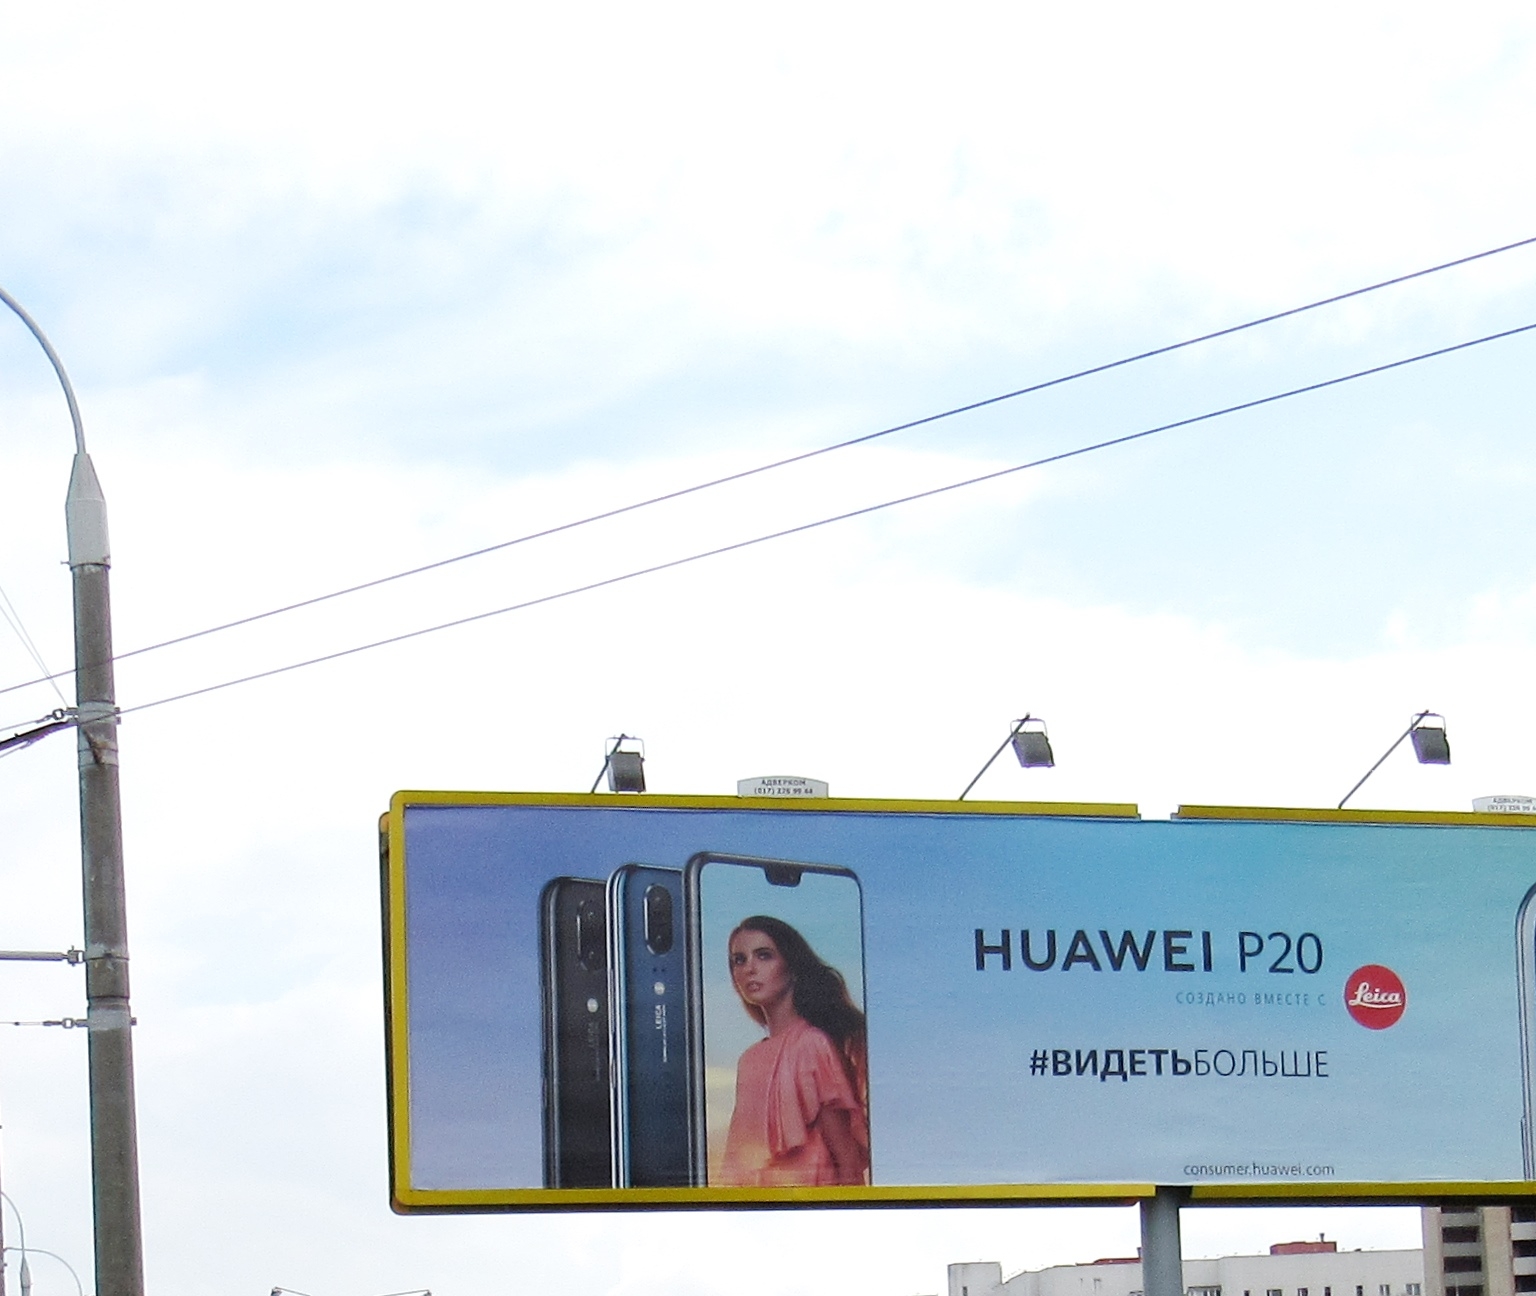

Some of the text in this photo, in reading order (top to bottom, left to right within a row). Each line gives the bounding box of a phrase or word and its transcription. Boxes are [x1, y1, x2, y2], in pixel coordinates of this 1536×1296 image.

[974, 928, 1324, 975] HUAWEI P20
[1175, 991, 1326, 1007] СОЗДАНО ВМЕСТЕ С
[1348, 981, 1403, 1009] Leica
[1029, 1048, 1330, 1083] #ВИДЕТЬБОЛЬШЕ
[1183, 1162, 1336, 1176] consumer.huawei.com
